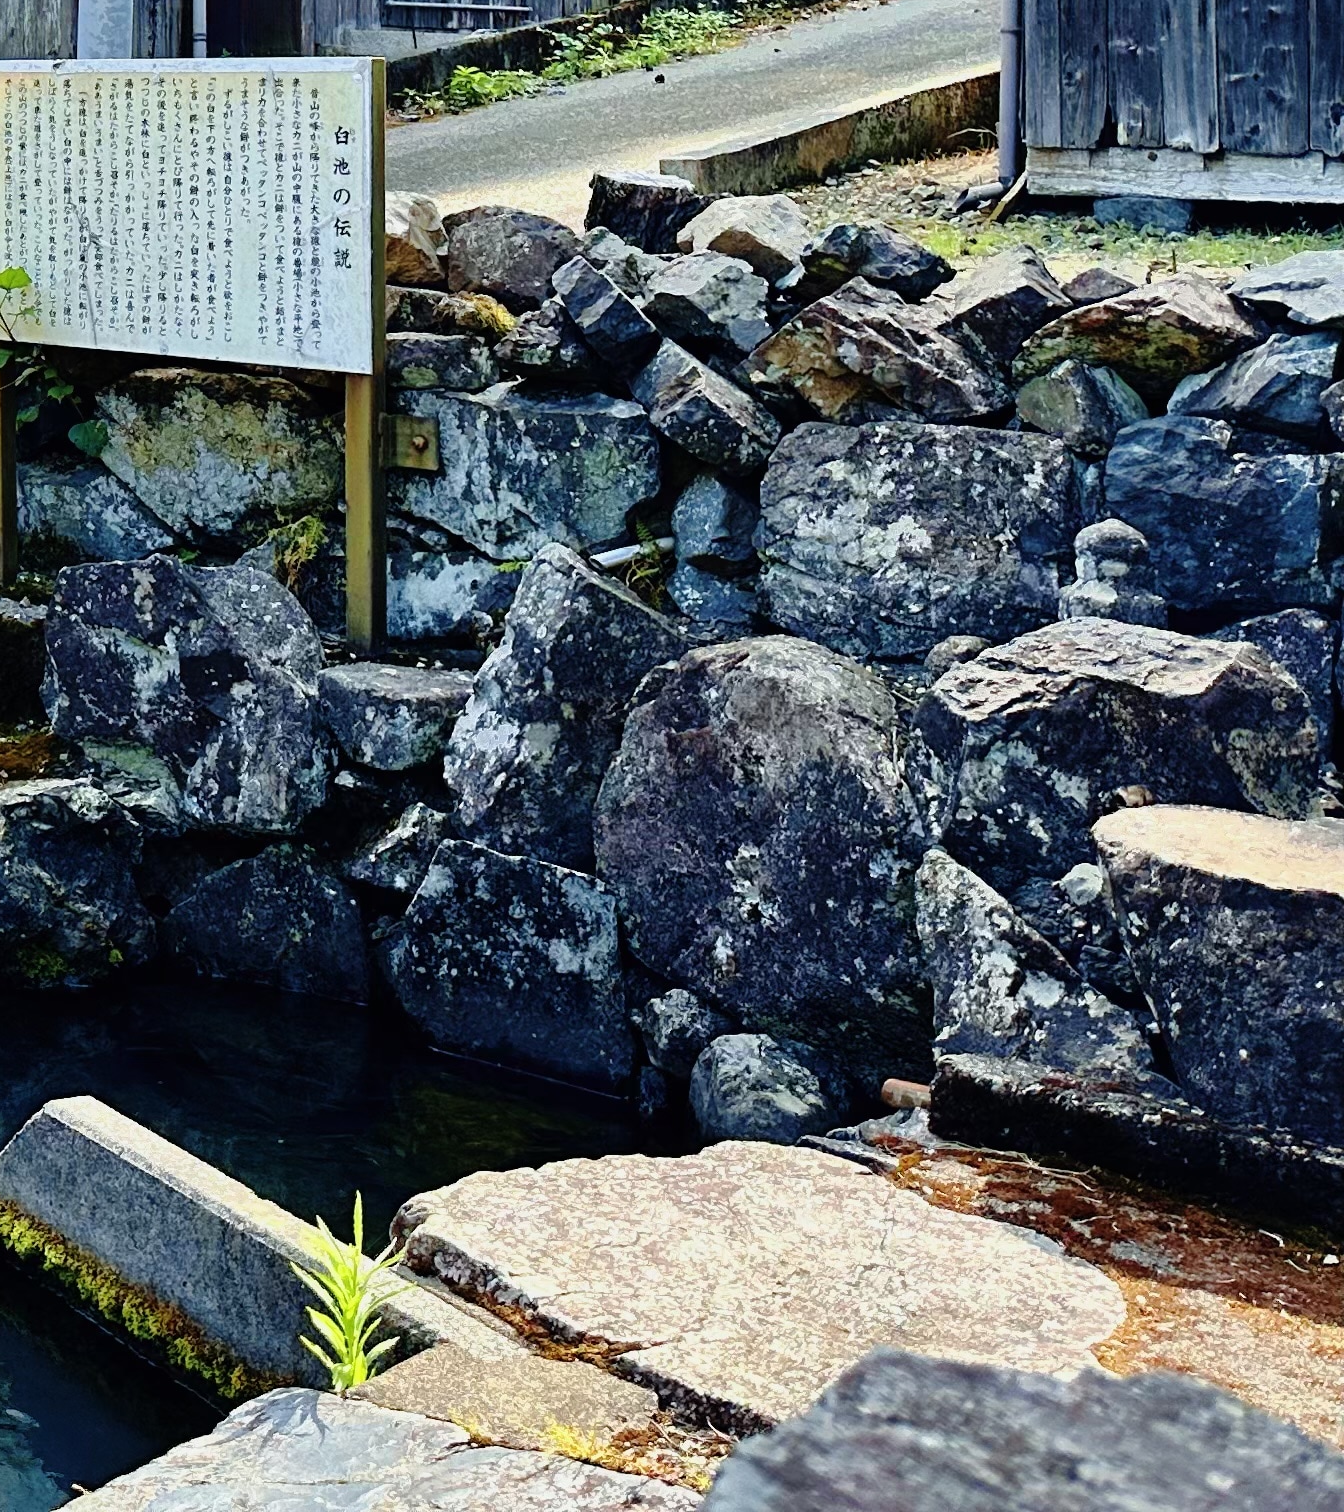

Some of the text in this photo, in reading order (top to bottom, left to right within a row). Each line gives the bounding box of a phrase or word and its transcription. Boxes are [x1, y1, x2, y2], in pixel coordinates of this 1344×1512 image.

[333, 125, 352, 270] 臼池の伝説
